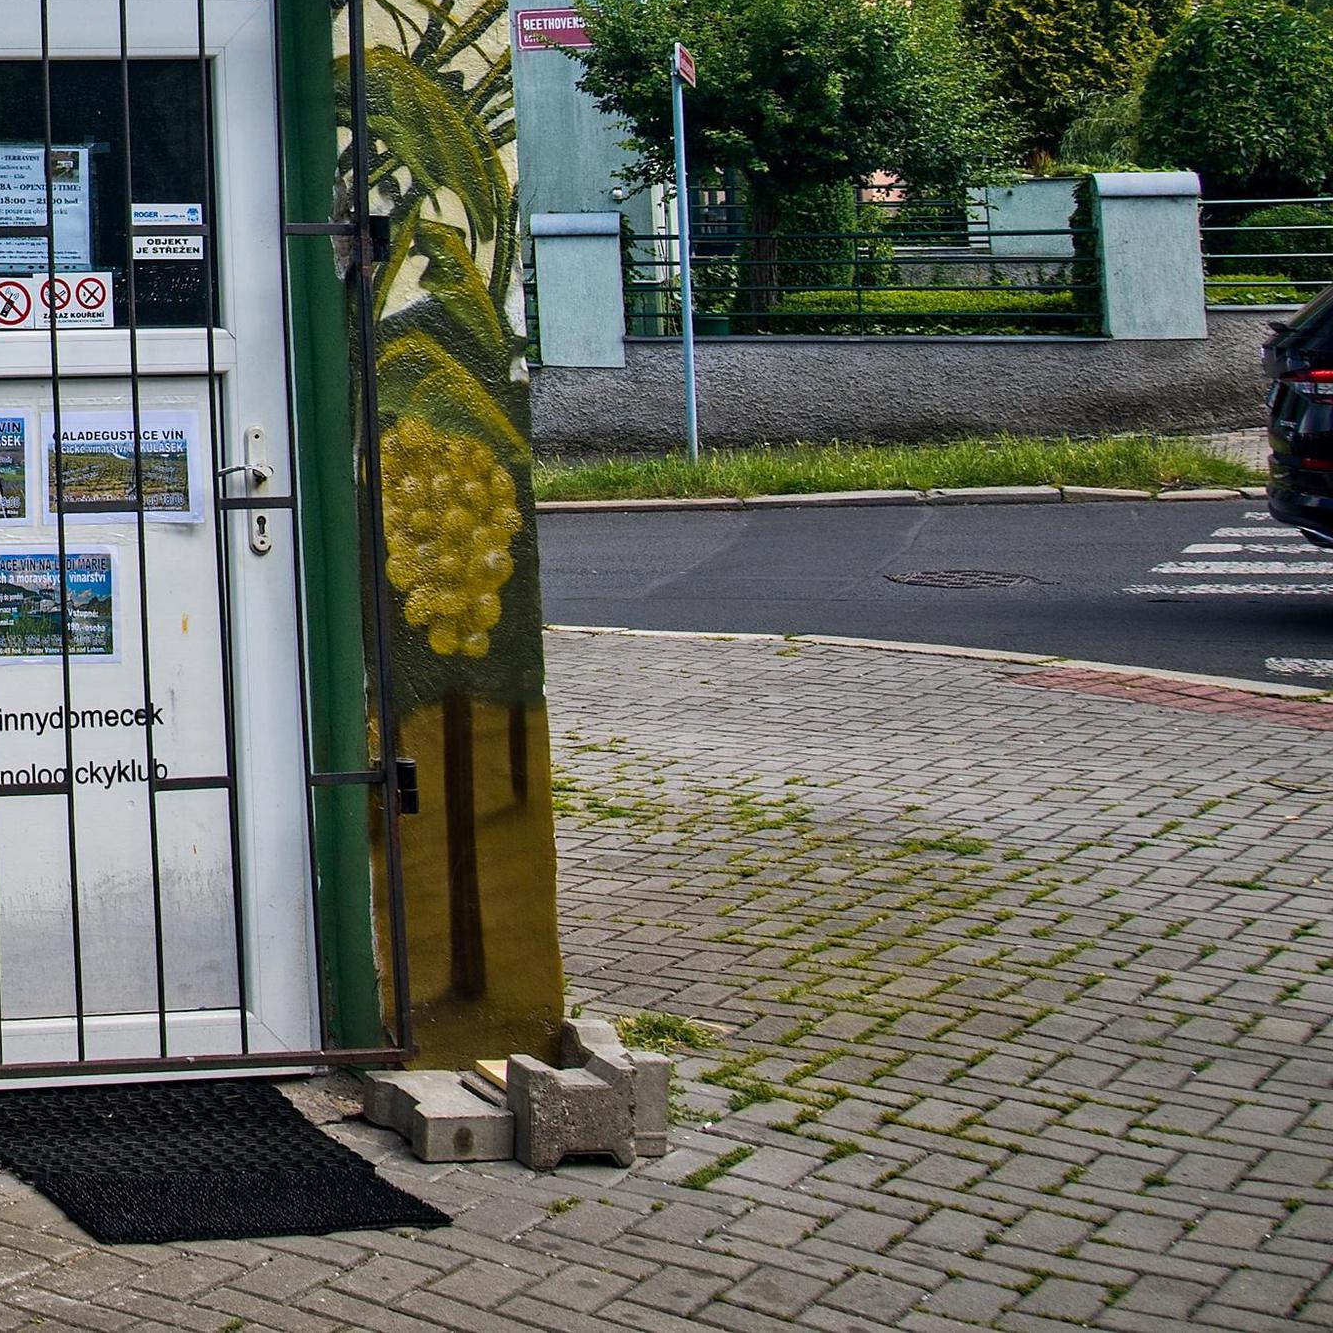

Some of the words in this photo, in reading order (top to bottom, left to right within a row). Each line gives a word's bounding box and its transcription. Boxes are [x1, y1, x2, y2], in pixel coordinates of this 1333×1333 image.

[0, 196, 26, 205] 18:00
[146, 238, 189, 246] OBJEKT
[152, 245, 200, 254] STŘEŽEN
[70, 310, 105, 319] KOUŘENÍ
[77, 558, 107, 571] MARIE
[8, 575, 14, 583] a
